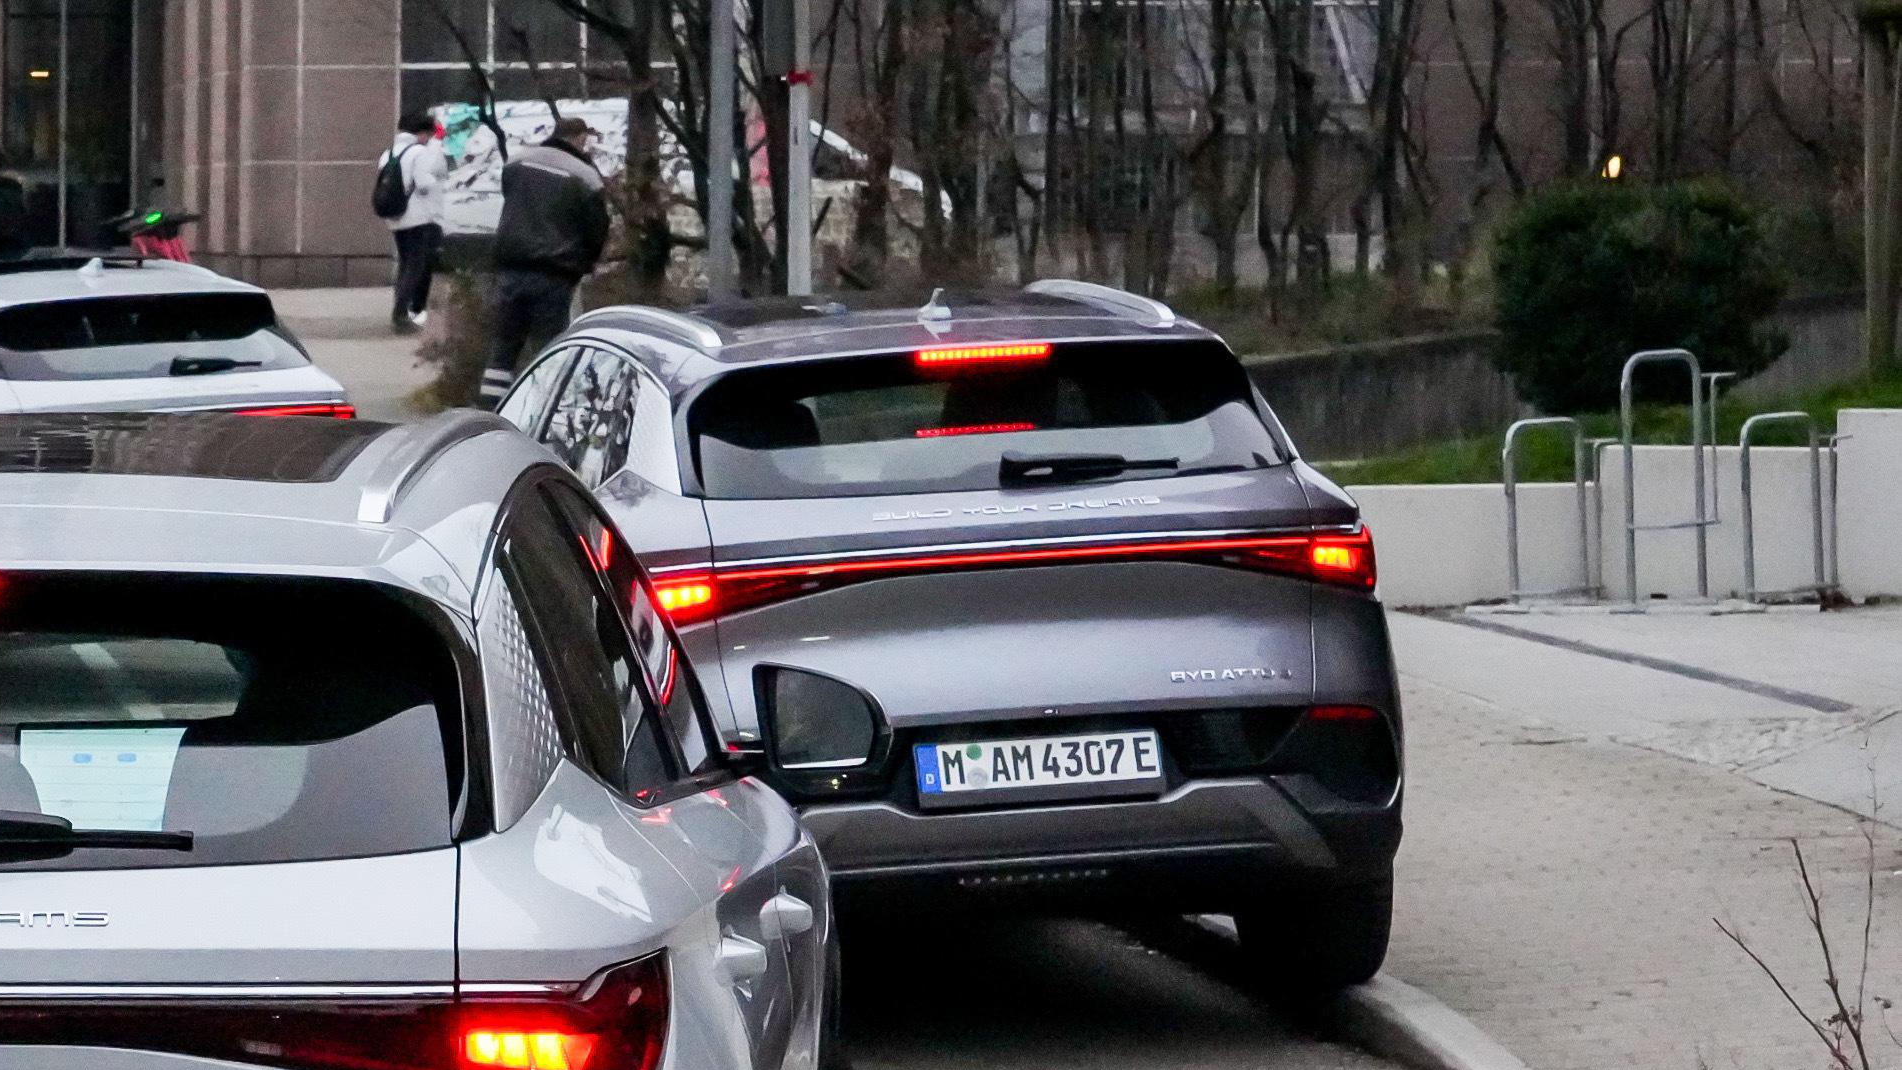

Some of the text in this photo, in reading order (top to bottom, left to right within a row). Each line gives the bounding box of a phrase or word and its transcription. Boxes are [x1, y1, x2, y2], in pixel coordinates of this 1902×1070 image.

[962, 503, 1039, 515] YOUR
[1170, 669, 1216, 683] BYD
[925, 773, 935, 785] D
